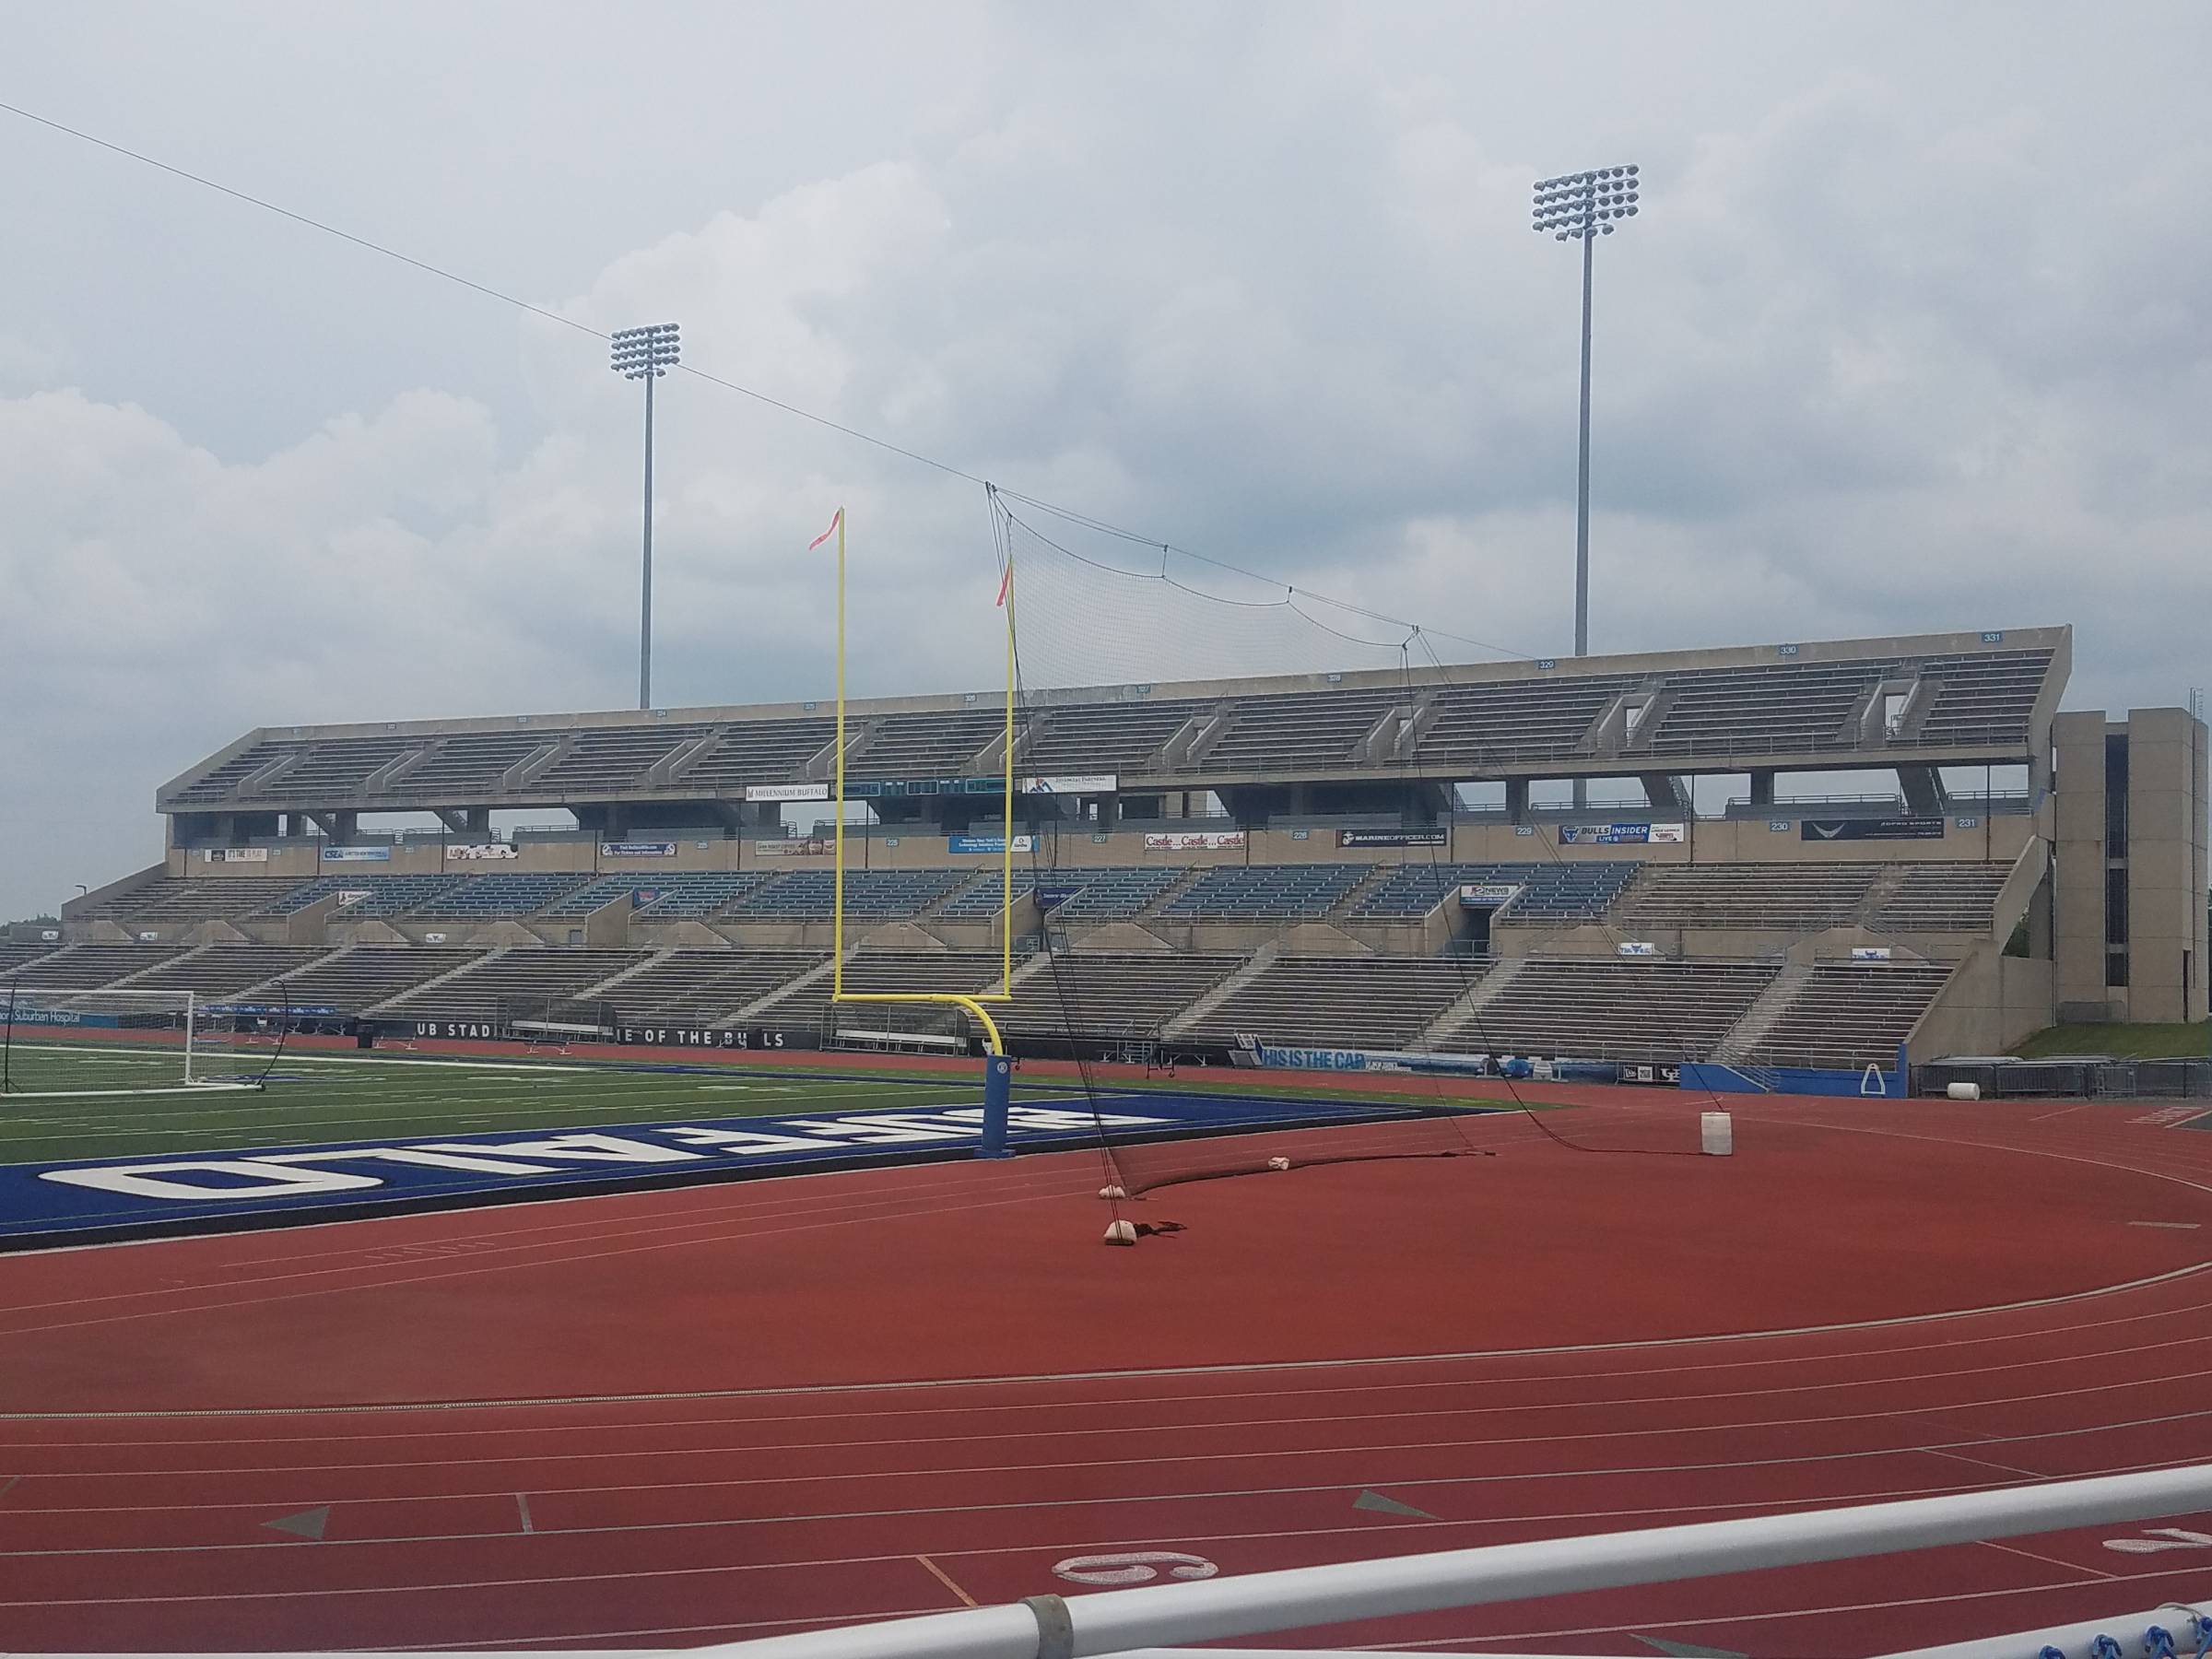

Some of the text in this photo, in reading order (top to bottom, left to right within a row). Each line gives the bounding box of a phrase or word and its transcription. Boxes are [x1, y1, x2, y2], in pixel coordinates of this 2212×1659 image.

[1983, 633, 2000, 642] 331
[755, 787, 828, 798] MILLENNIUM BUFFALO
[1771, 822, 1788, 831] 230
[1958, 818, 1975, 828] 231
[1517, 827, 1532, 835] 229
[1581, 827, 1609, 835] BULLS
[1611, 826, 1649, 835] INSIDER
[15, 1010, 49, 1022] Suburban
[417, 1023, 437, 1036] UB
[644, 1030, 666, 1043] OF
[677, 1030, 712, 1045] THE
[1261, 1048, 1288, 1066] HIS
[1303, 1050, 1333, 1069] THE
